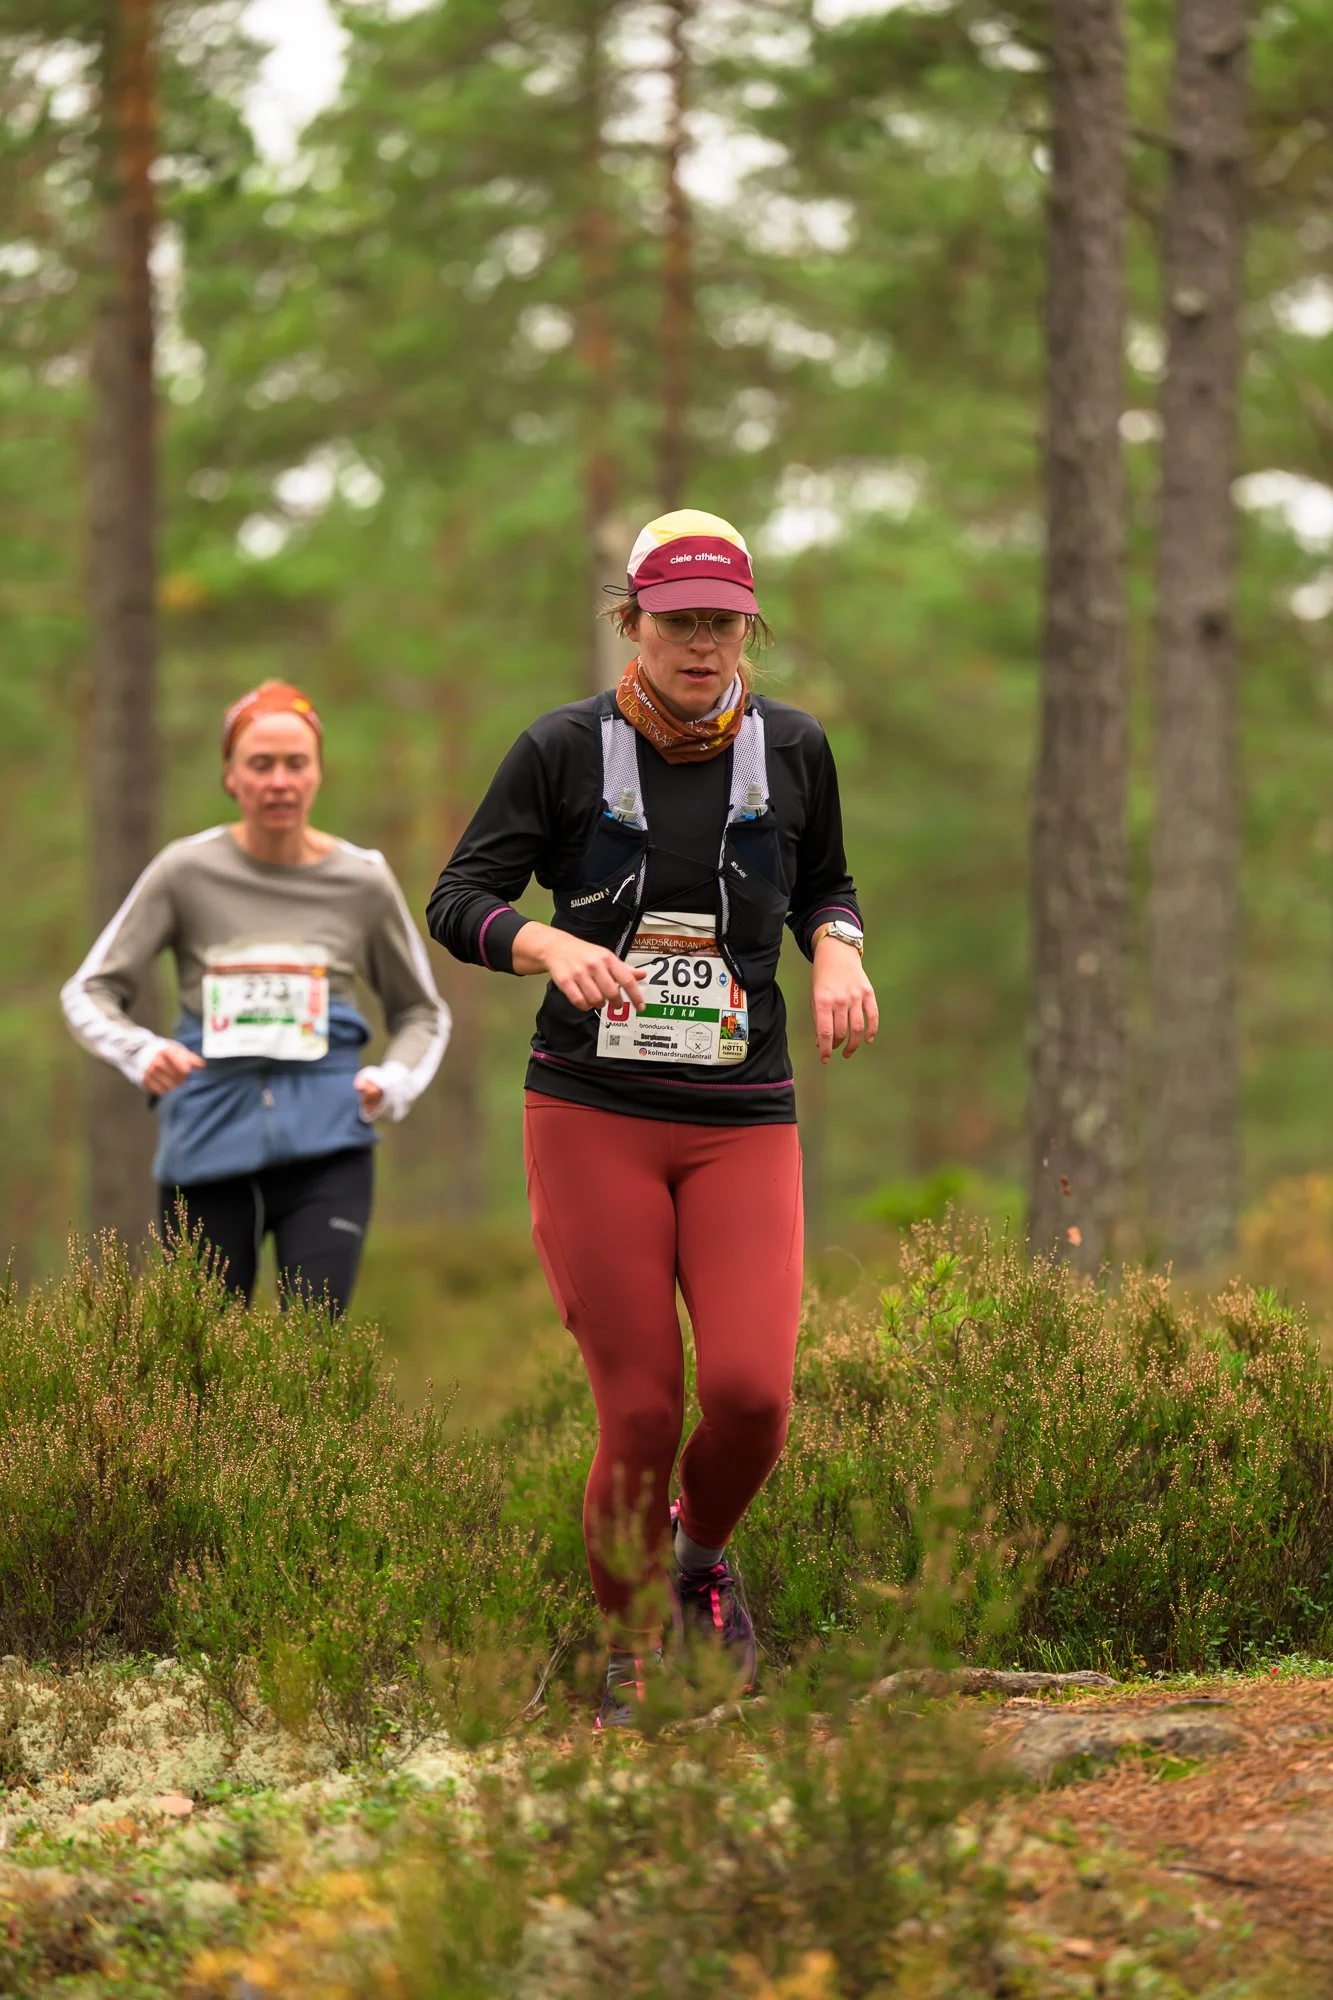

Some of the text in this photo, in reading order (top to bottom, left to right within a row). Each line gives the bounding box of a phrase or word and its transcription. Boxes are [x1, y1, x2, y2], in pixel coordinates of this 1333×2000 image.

[670, 552, 731, 565] ciele athletics
[649, 957, 713, 989] 269
[660, 990, 700, 1006] Suus
[662, 1007, 695, 1018] 10 KM
